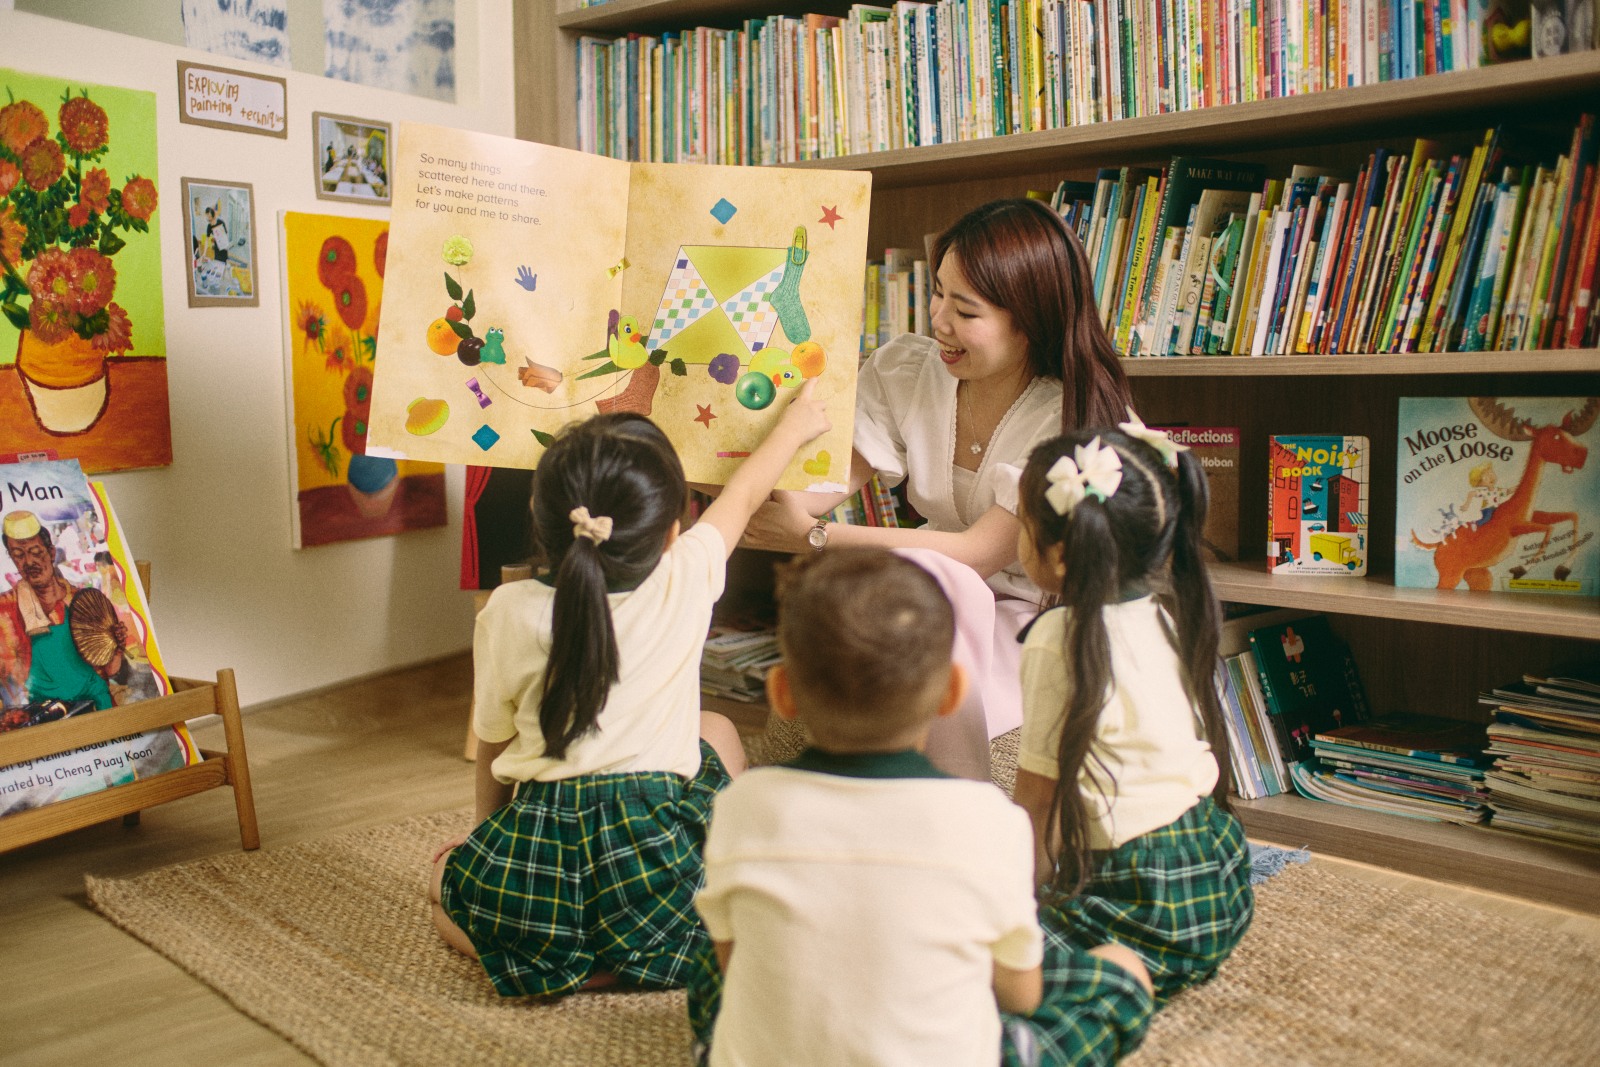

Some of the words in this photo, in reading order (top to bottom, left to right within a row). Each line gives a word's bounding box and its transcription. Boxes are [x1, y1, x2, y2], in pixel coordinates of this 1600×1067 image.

[420, 153, 434, 164] So
[437, 158, 468, 172] many
[470, 161, 502, 176] things
[416, 183, 442, 196] Let's
[444, 188, 474, 200] make
[476, 193, 520, 208] patterns
[418, 170, 469, 184] scattered
[472, 177, 495, 189] here
[498, 182, 518, 192] and
[520, 184, 548, 198] there.
[416, 198, 430, 209] for
[433, 202, 453, 214] you
[456, 205, 477, 216] and
[480, 208, 496, 219] me
[499, 211, 509, 221] to
[512, 213, 542, 226] share.
[1133, 236, 1145, 268] Telling
[1128, 276, 1137, 298] Time
[1404, 422, 1478, 456] Moose
[1201, 456, 1234, 468] Hoban
[1282, 466, 1322, 478] BOOK
[1404, 468, 1423, 484] on
[1420, 453, 1446, 472] the
[1443, 441, 1514, 464] Loose
[8, 481, 64, 502] Man
[38, 774, 52, 786] by
[54, 764, 92, 780] Cheng
[94, 756, 124, 772] Puay
[124, 748, 152, 761] Koon
